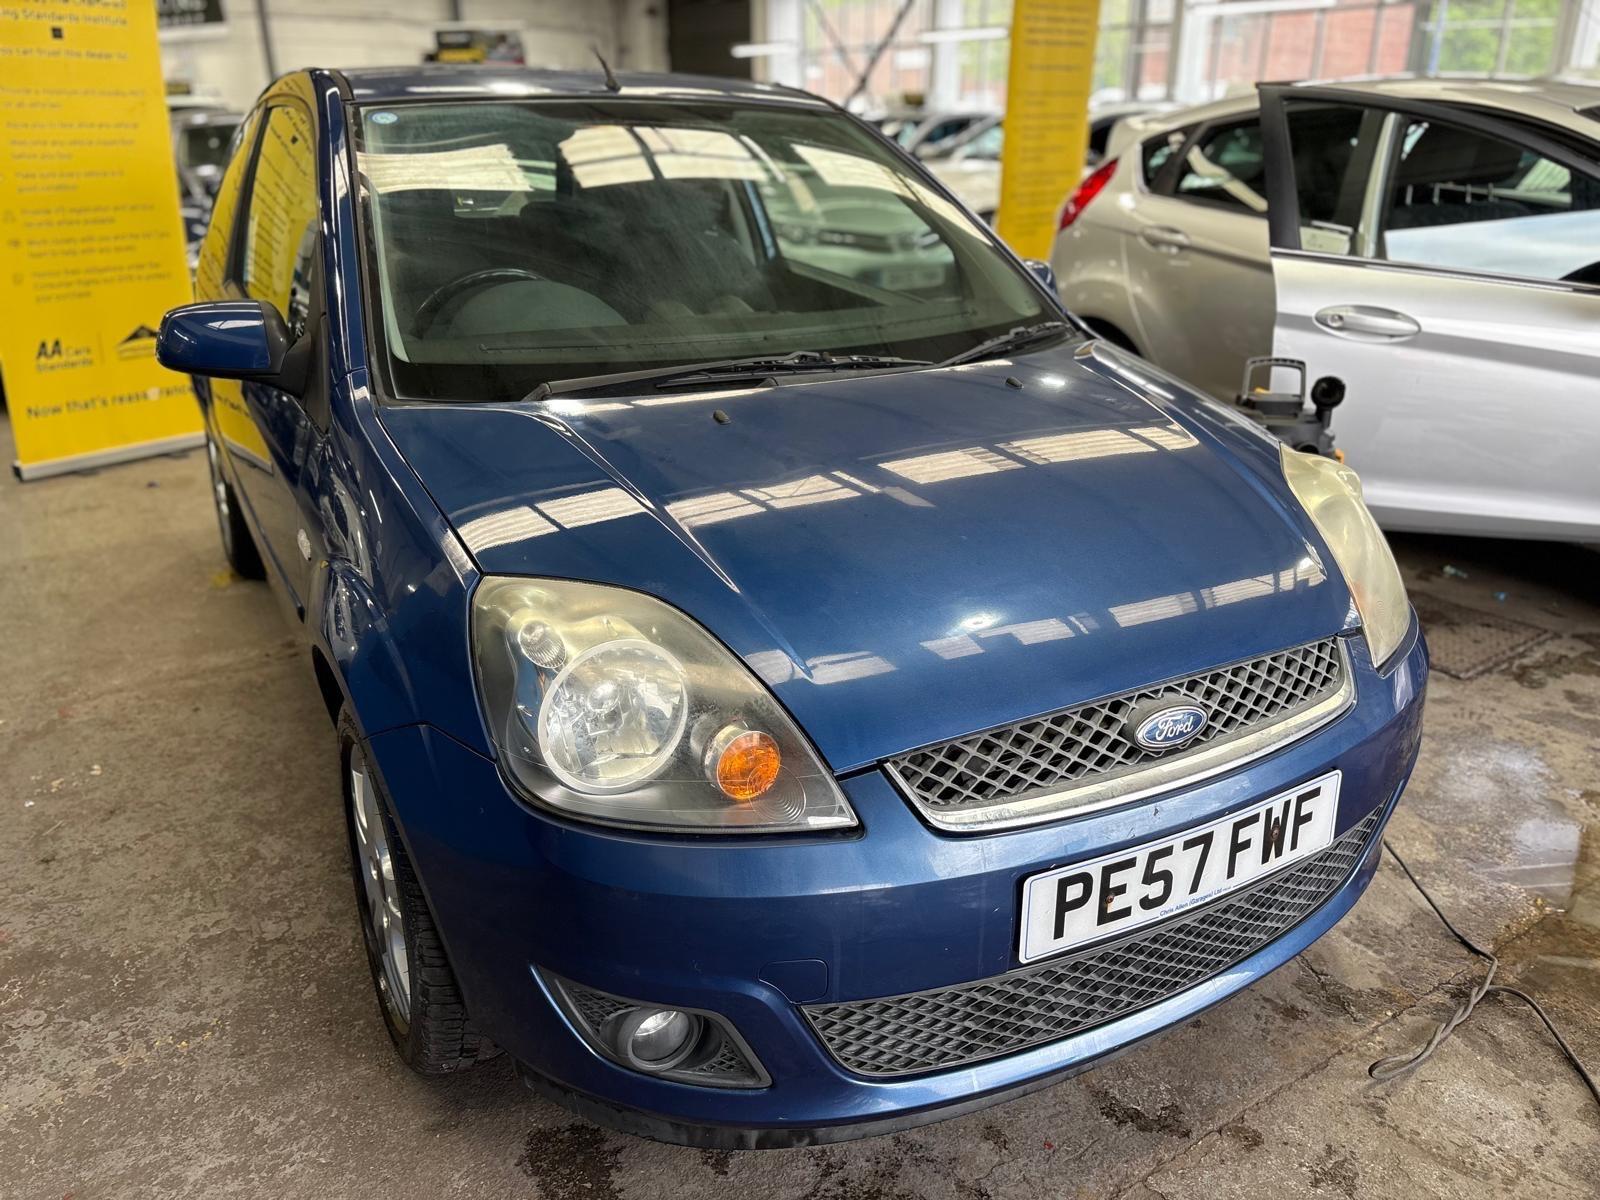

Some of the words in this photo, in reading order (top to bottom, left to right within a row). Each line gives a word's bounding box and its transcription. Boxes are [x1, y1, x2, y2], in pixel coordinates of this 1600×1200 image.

[36, 339, 62, 360] AA
[26, 403, 62, 418] Now
[66, 394, 109, 412] that's
[1155, 715, 1194, 741] Ford
[1053, 831, 1215, 940] PE57
[1226, 786, 1321, 879] FWF
[1160, 907, 1174, 917] Chris
[1175, 902, 1188, 911] Allen
[1189, 891, 1213, 906] (Garages)
[1214, 887, 1222, 895] Ltd
